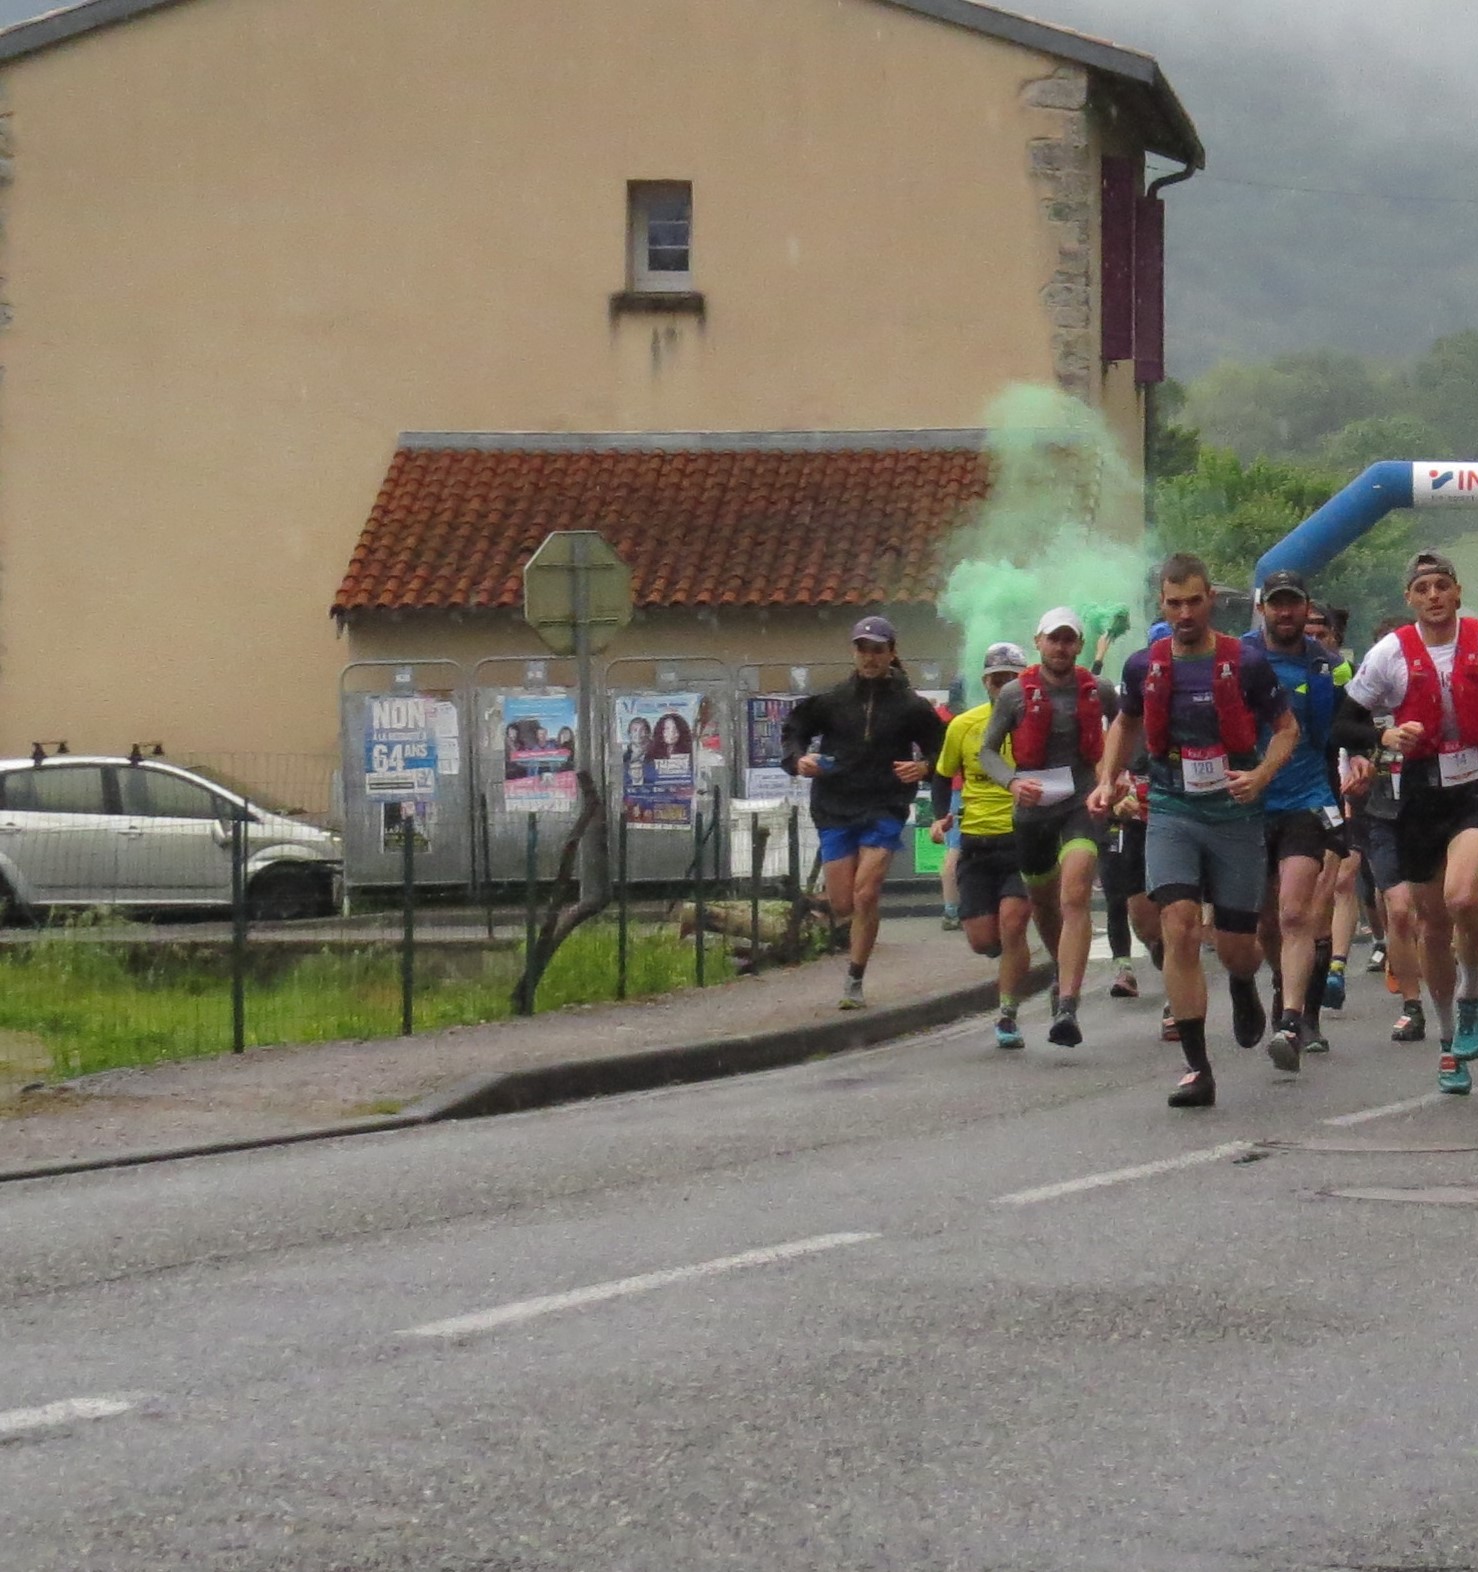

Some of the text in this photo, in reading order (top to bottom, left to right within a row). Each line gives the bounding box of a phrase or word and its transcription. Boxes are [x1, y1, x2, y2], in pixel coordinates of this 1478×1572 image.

[373, 700, 426, 729] NON
[373, 743, 428, 772] 64 ANS
